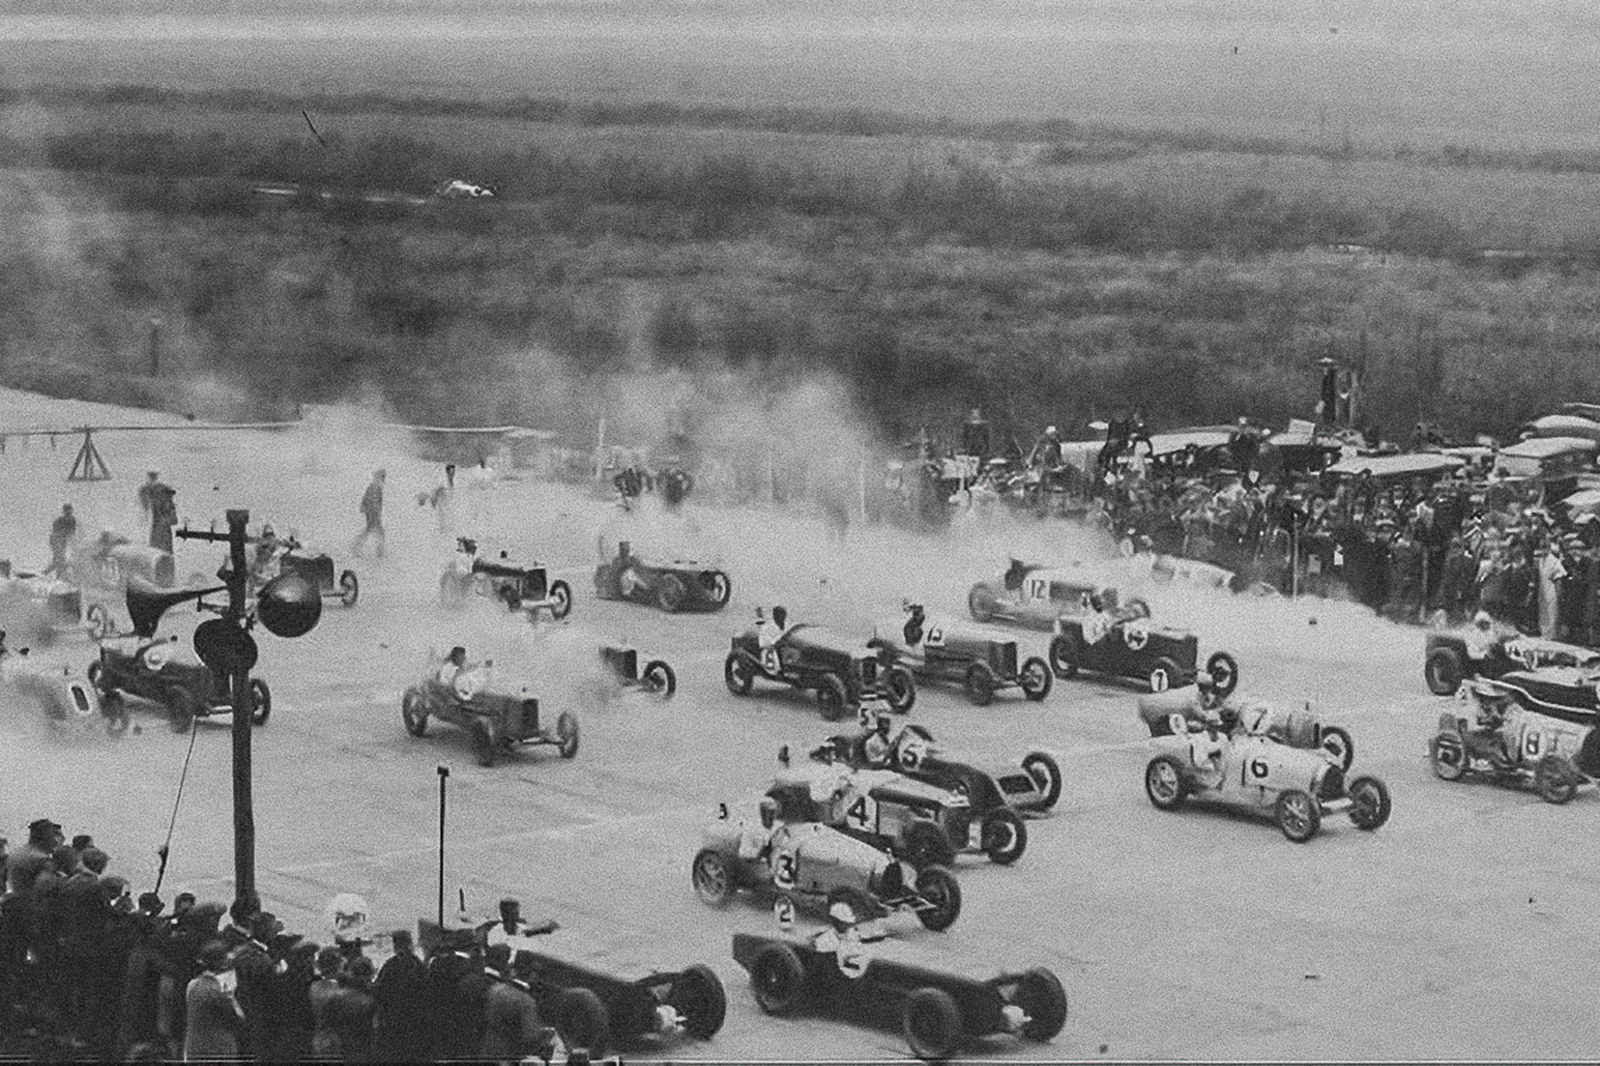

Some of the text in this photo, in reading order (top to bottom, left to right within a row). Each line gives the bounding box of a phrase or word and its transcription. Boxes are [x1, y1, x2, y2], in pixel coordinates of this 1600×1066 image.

[1030, 580, 1046, 599] 12
[1155, 671, 1164, 691] 7
[1252, 707, 1268, 731] 7
[901, 743, 919, 769] 5
[1525, 732, 1540, 756] 8
[717, 802, 728, 820] 3
[848, 796, 870, 827] 4
[777, 853, 796, 885] 3
[779, 902, 791, 922] 2
